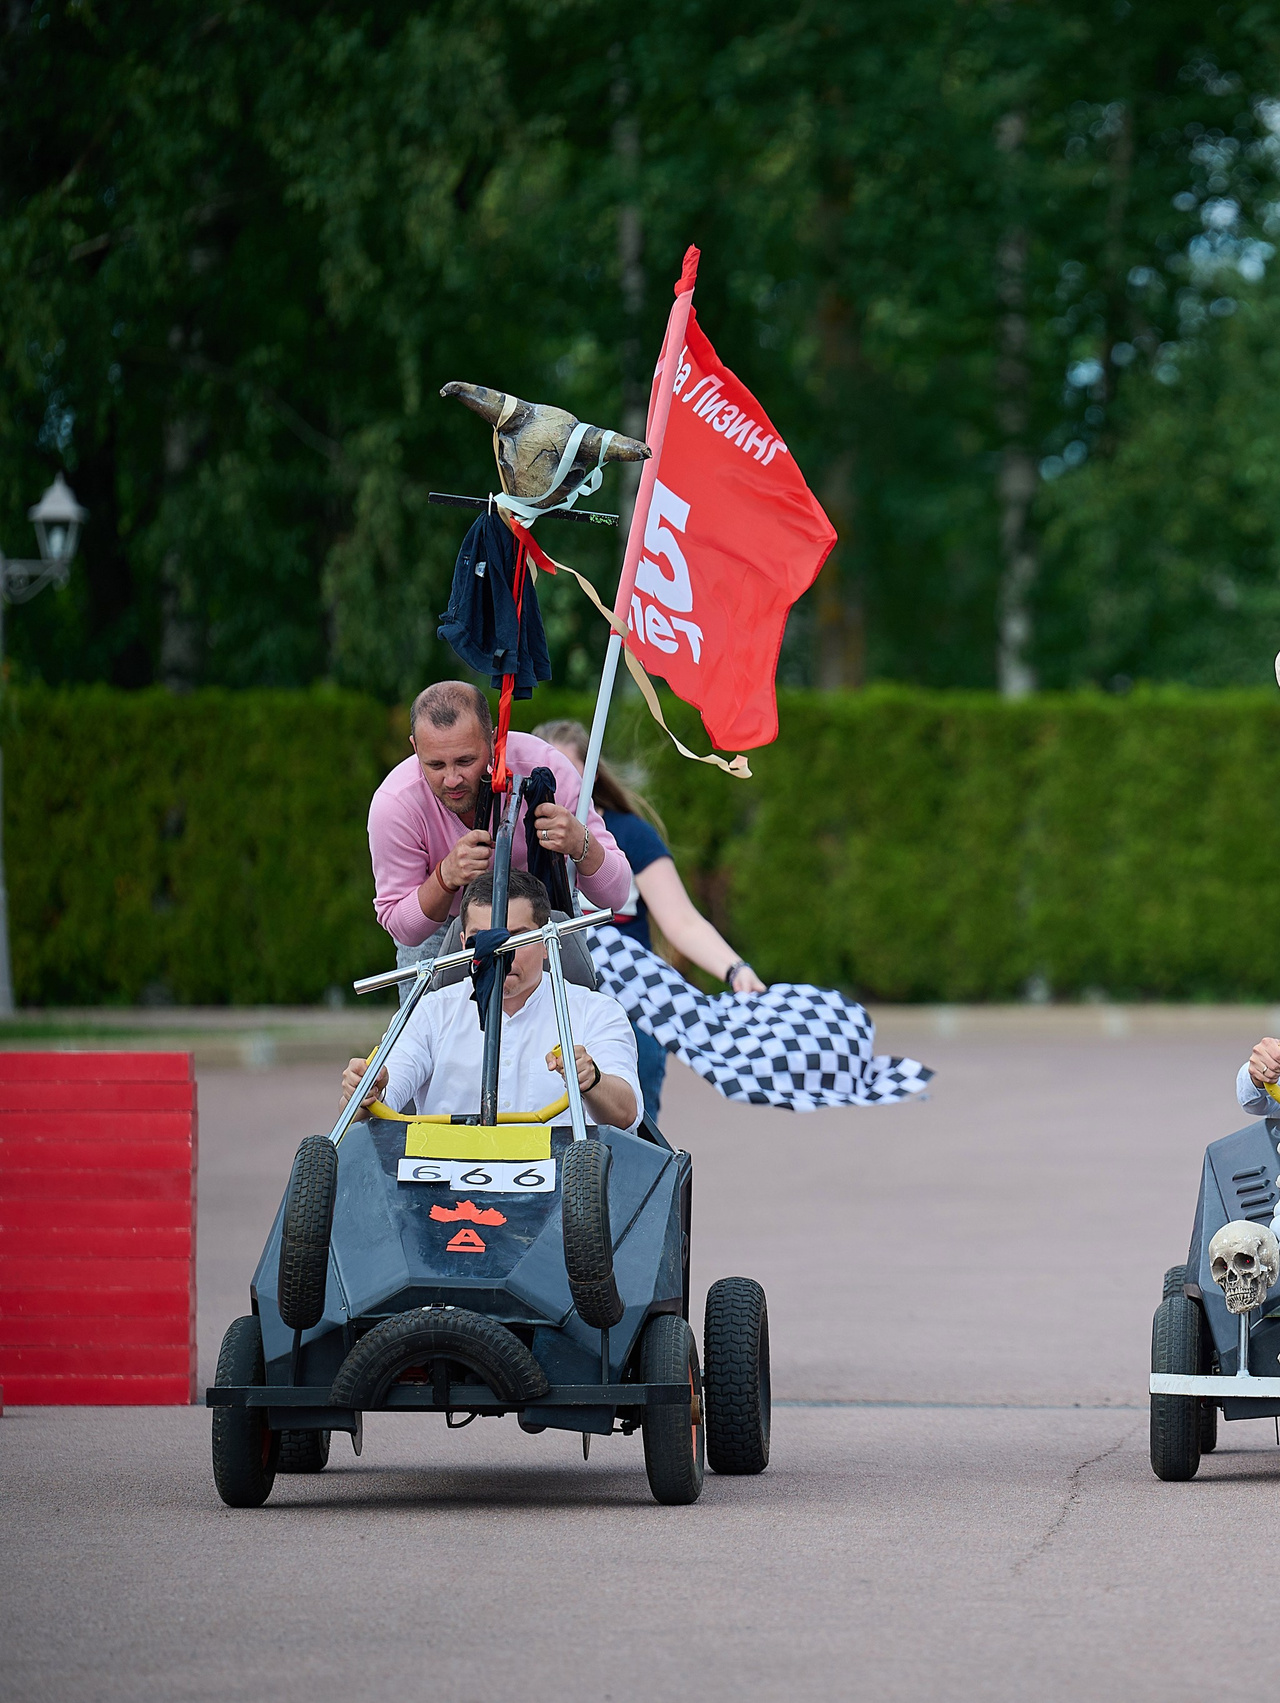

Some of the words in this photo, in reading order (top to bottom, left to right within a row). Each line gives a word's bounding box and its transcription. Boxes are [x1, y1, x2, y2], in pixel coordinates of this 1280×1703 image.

[682, 374, 788, 467] Лизинг
[634, 477, 694, 613] 5
[627, 592, 704, 665] лет
[412, 1165, 545, 1186] 666
